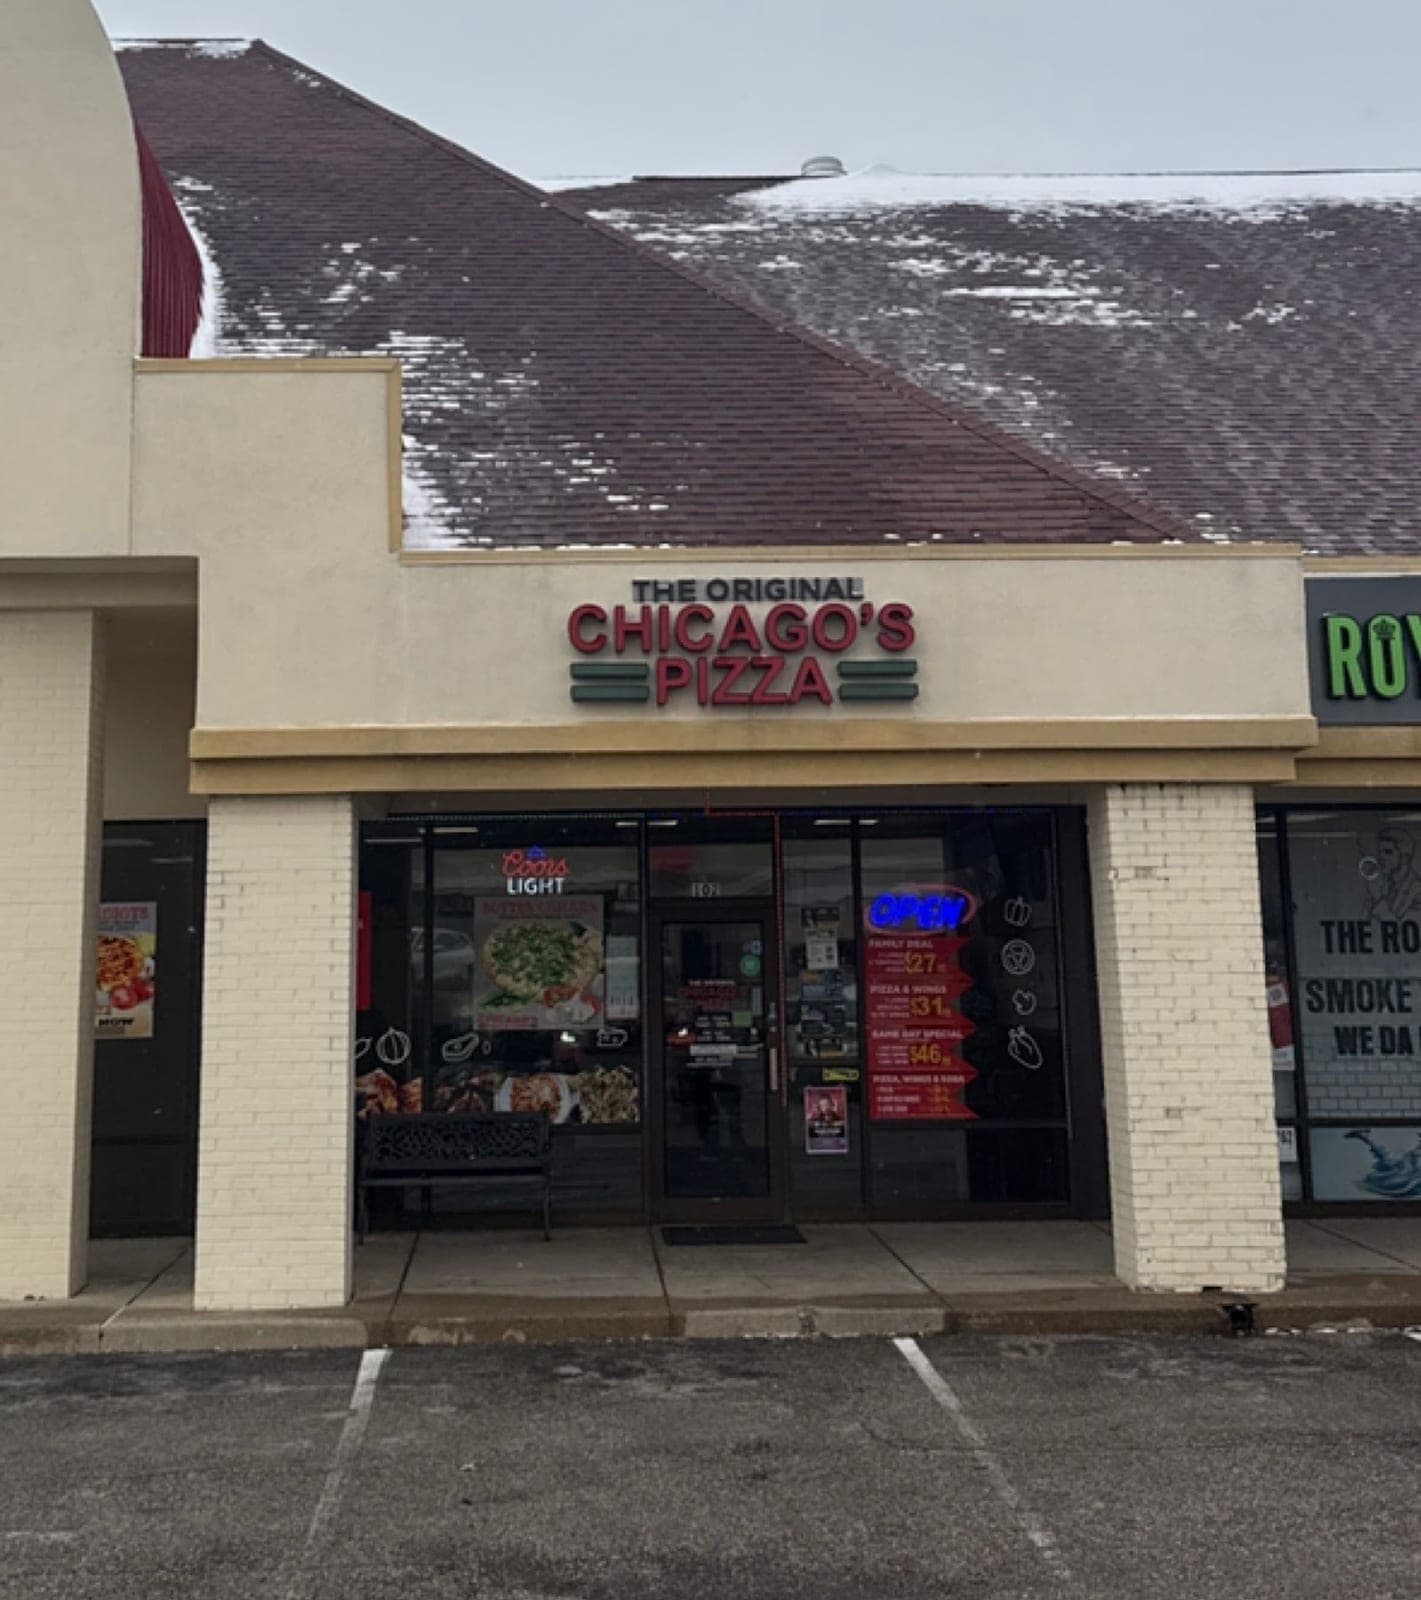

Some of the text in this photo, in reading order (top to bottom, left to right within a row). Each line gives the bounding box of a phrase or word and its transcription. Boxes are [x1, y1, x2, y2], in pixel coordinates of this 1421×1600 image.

[632, 576, 865, 603] THE ORIGINAL
[567, 602, 916, 653] CHICAGO'S
[655, 656, 834, 706] PIZZA
[502, 849, 569, 876] Coors
[507, 876, 566, 895] LIGHT
[869, 892, 966, 929] OPEN
[1320, 919, 1374, 955] THE
[1305, 978, 1413, 1014] SMOKE
[1333, 1026, 1374, 1056] WE
[1378, 1026, 1414, 1056] DA
